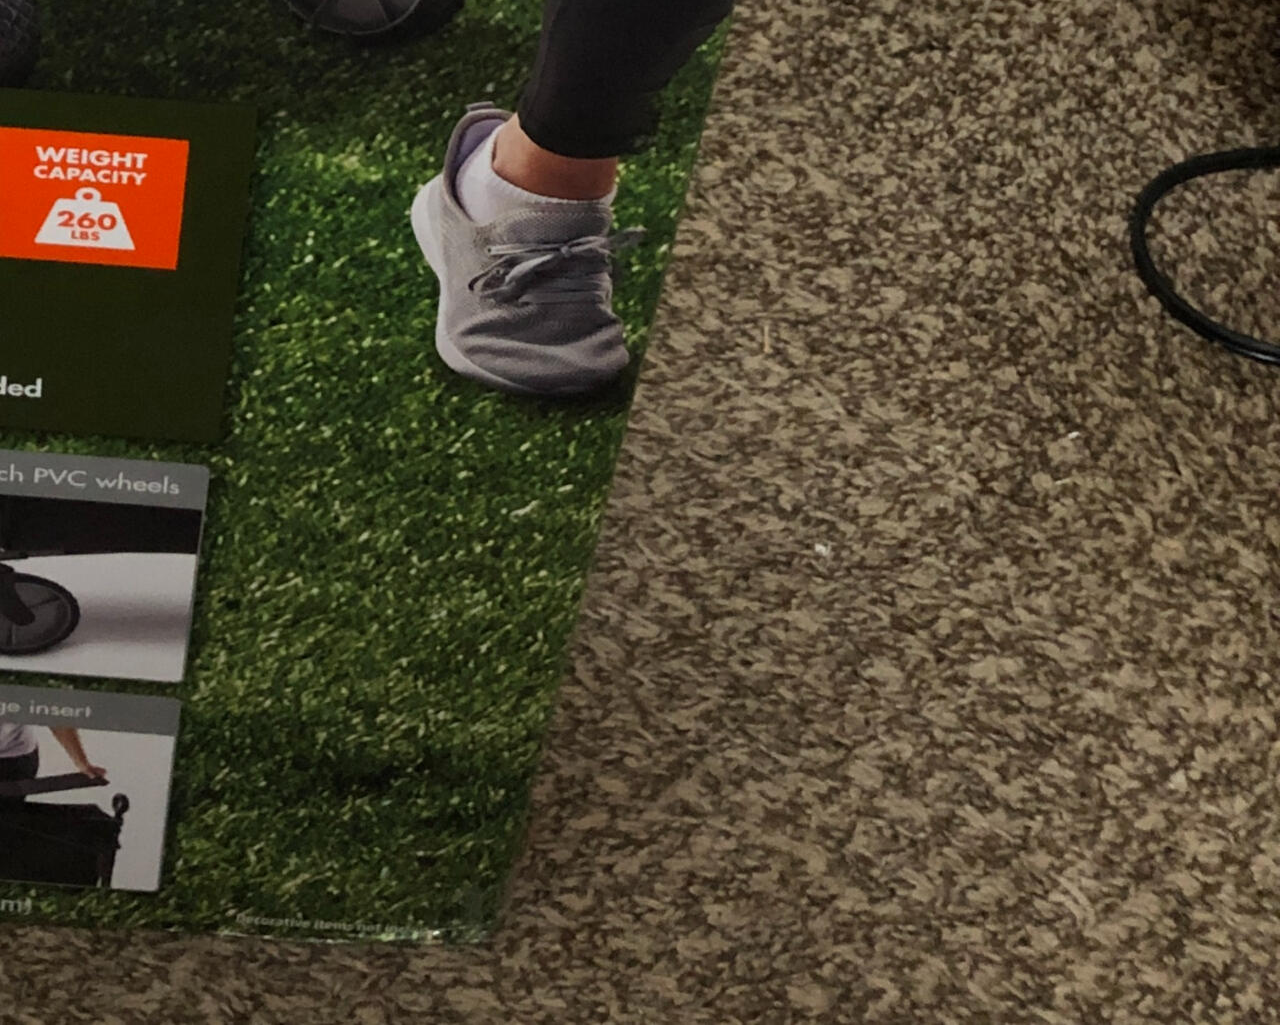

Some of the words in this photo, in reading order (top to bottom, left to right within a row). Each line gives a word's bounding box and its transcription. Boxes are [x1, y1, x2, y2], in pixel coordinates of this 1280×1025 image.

[35, 145, 148, 169] WEIGHT
[33, 165, 147, 186] CAPACITY
[57, 210, 117, 231] 260
[70, 230, 100, 242] LBS
[33, 467, 87, 488] PVC
[95, 472, 181, 496] wheels
[28, 699, 93, 719] insert
